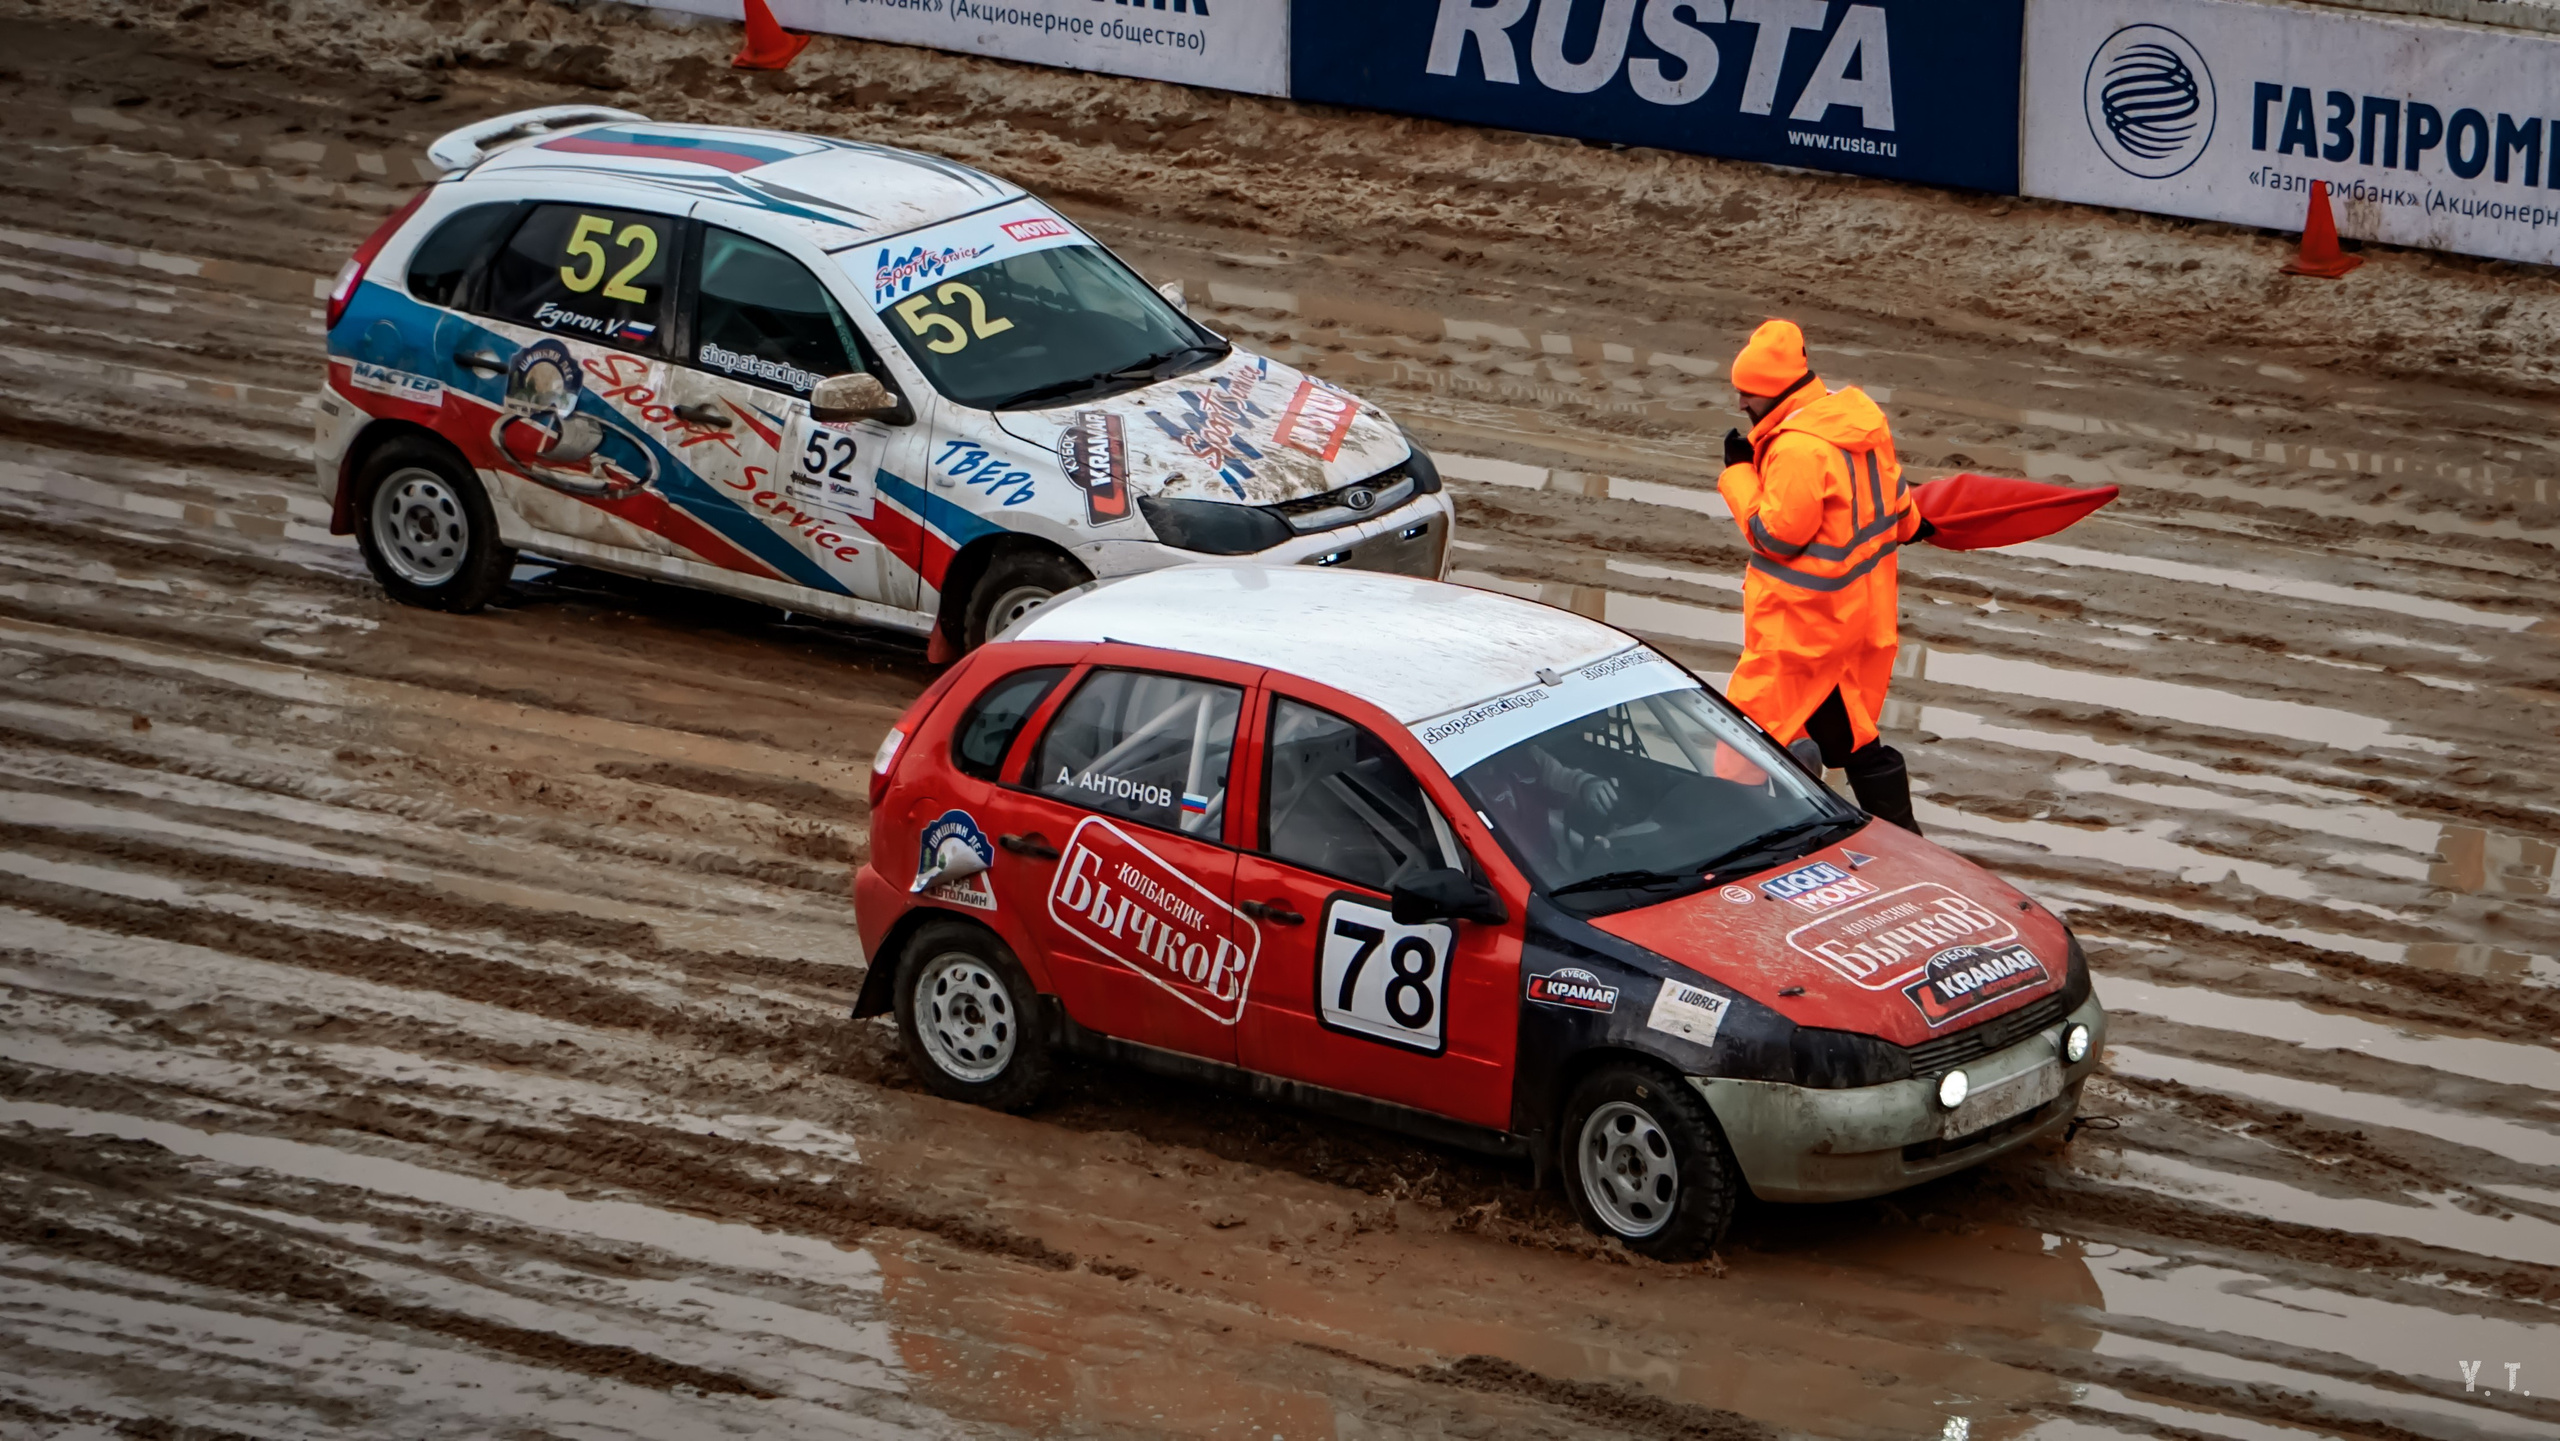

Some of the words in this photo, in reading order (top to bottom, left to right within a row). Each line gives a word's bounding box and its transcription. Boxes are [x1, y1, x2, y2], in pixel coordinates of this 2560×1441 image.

[950, 0, 1094, 36] (Акционерное
[1100, 18, 1206, 57] общество)
[1426, 0, 1896, 132] RUSTA
[1788, 129, 1898, 158] www.rusta.ru
[1008, 219, 1066, 240] MOTUL
[560, 213, 658, 304] 52
[875, 250, 935, 290] Sport
[894, 281, 1015, 354] 52
[354, 361, 440, 392] МАСТЕР
[803, 429, 857, 483] 52
[1061, 434, 1080, 474] КУБОК
[1085, 413, 1112, 487] KRAMAR
[935, 440, 1036, 506] ТВЕРЬ
[723, 466, 860, 563] Service
[1423, 688, 1550, 745] shop.at-racing.ru
[1079, 771, 1172, 808] АНТОНОВ
[929, 822, 969, 849] ШИШКИН
[1117, 861, 1206, 932] КОЛБАСНИК
[1765, 863, 1846, 898] LIQUI
[1793, 877, 1870, 912] MOLY
[1843, 901, 1921, 937] КОЛБАСНИК
[1334, 917, 1436, 1030] 78
[1561, 969, 1592, 983] КУБОК
[1931, 947, 1979, 970] КУБОК
[1935, 950, 2039, 999] KRAMAR
[1678, 988, 1723, 1013] LUBREX
